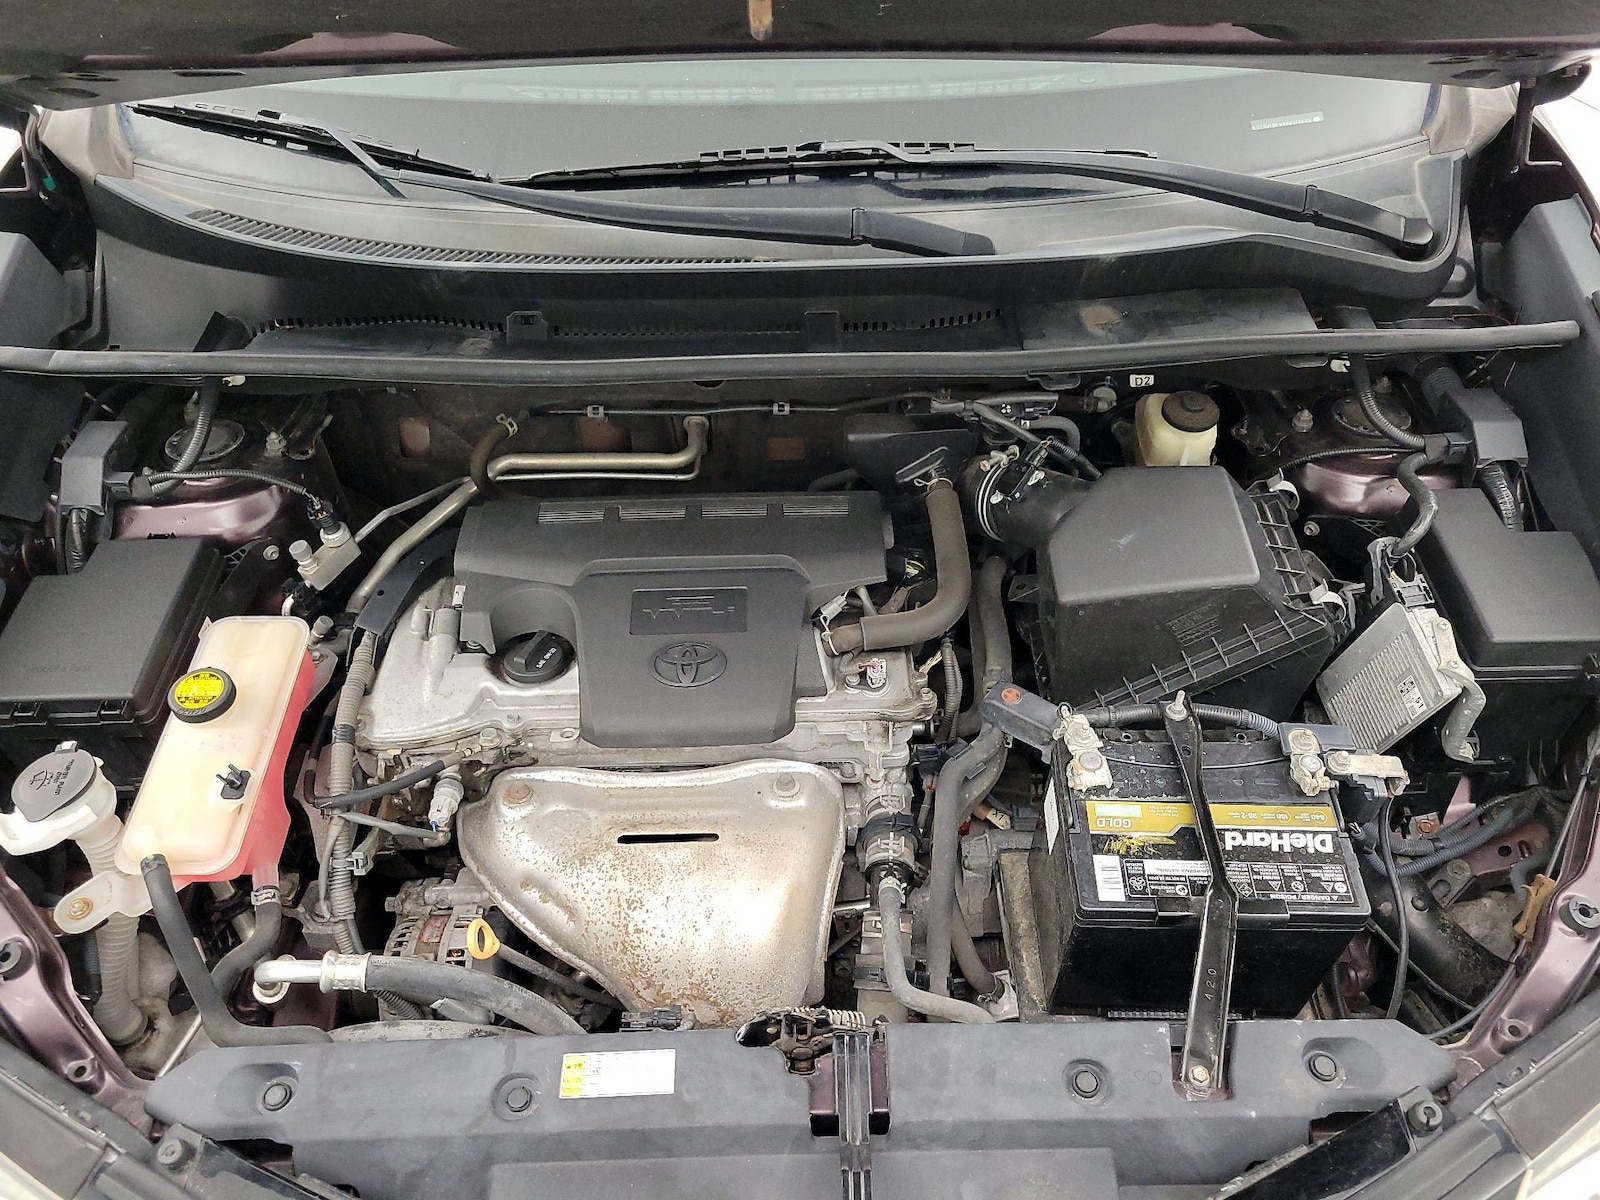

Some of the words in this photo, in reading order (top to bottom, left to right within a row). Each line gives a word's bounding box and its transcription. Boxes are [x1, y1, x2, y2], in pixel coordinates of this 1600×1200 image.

[1135, 376, 1151, 386] D2
[1096, 817, 1132, 828] GOLD
[1224, 831, 1334, 853] DieHard
[1204, 968, 1217, 1001] 420
